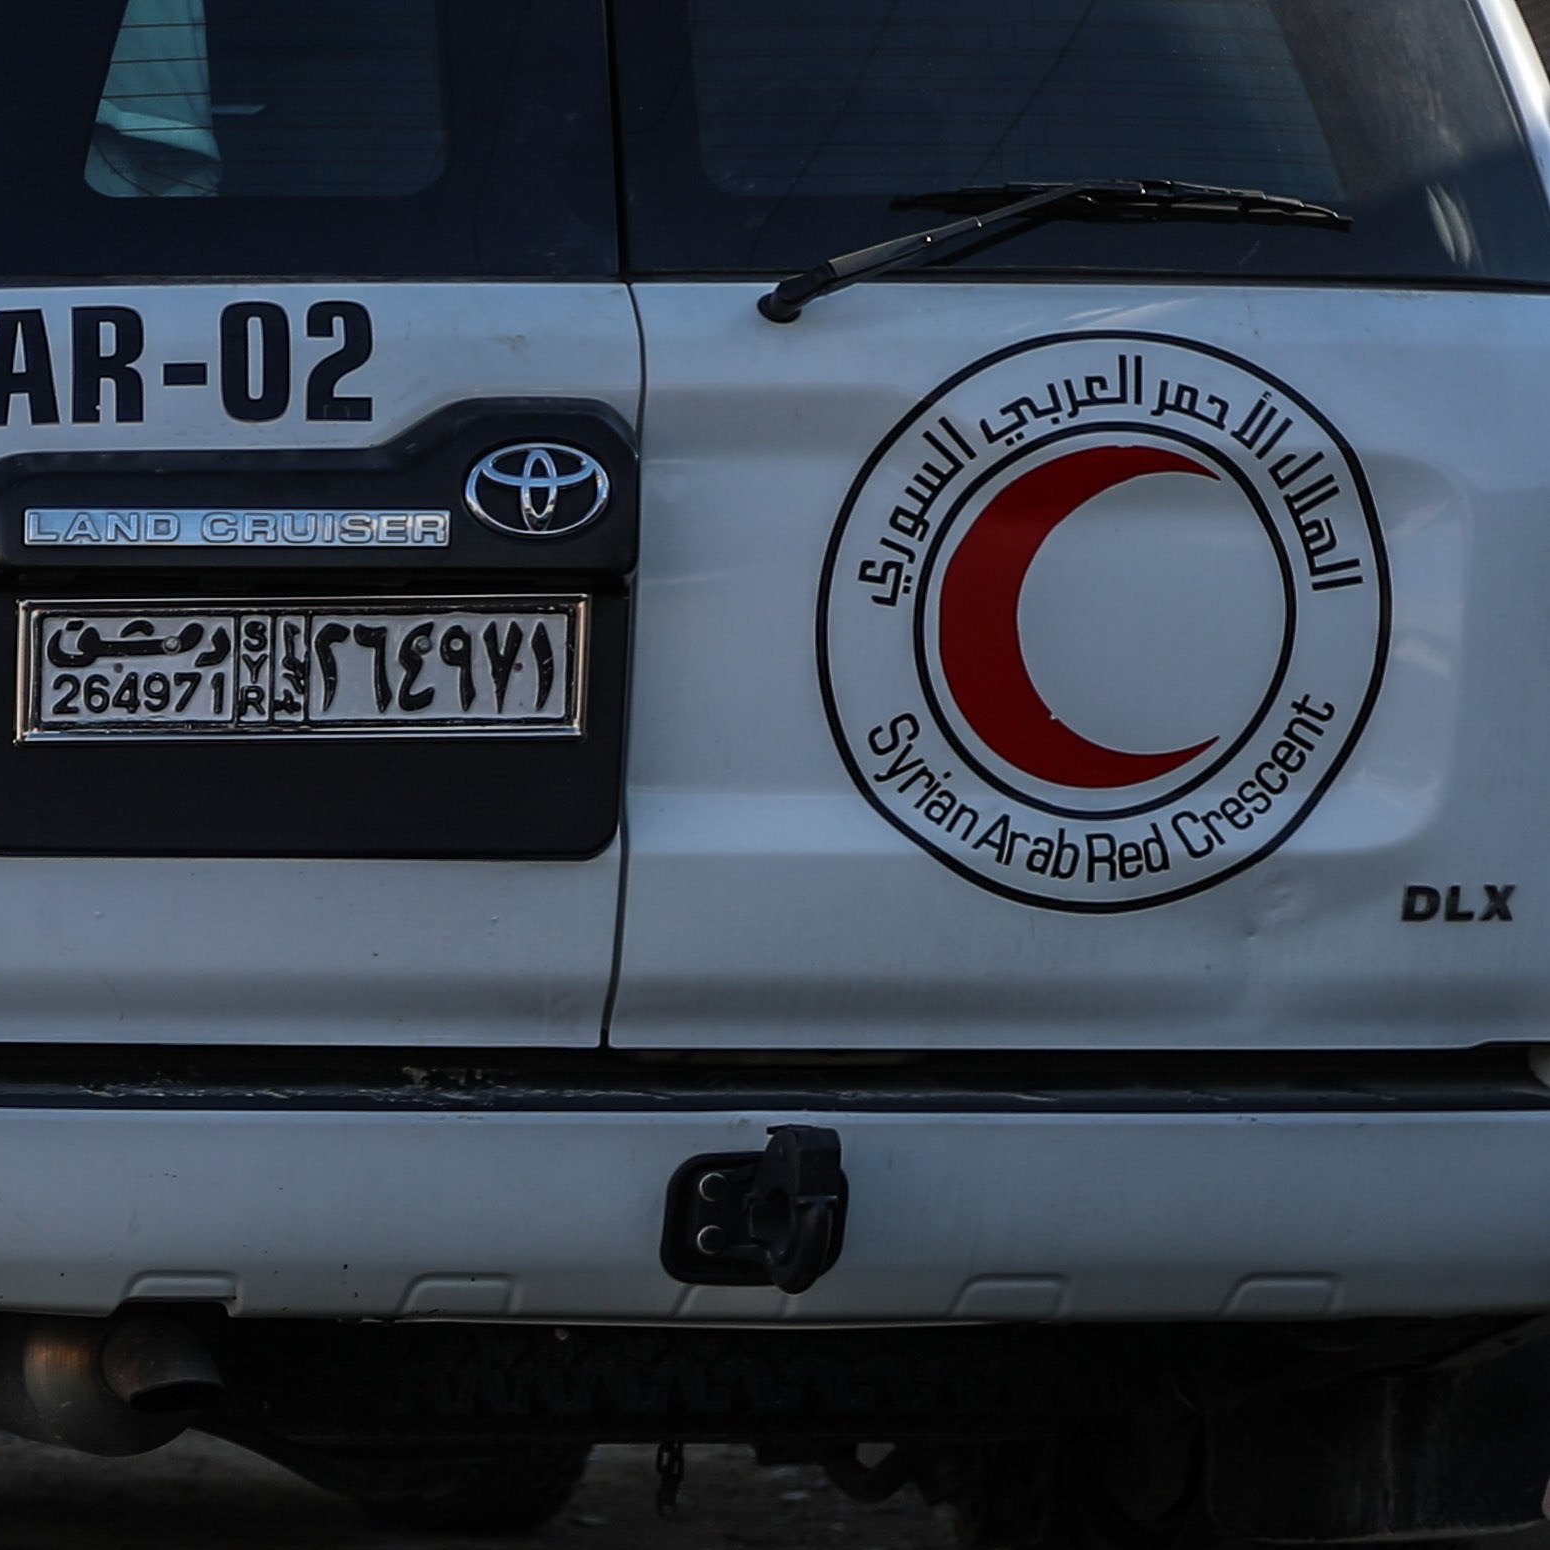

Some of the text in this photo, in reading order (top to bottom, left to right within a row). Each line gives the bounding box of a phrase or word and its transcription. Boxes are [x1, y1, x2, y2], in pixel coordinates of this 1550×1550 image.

[858, 354, 1364, 607] الهلال الأحمر العربي السوري
[26, 512, 448, 546] LAND CRUISER
[46, 618, 233, 668] دمشق
[239, 620, 268, 717] SYR
[314, 618, 555, 717] ٢٦٤٩٧١
[52, 670, 226, 716] 264971
[867, 693, 1337, 884] Syrian Arab Red Crescent
[1401, 884, 1516, 922] DLX
